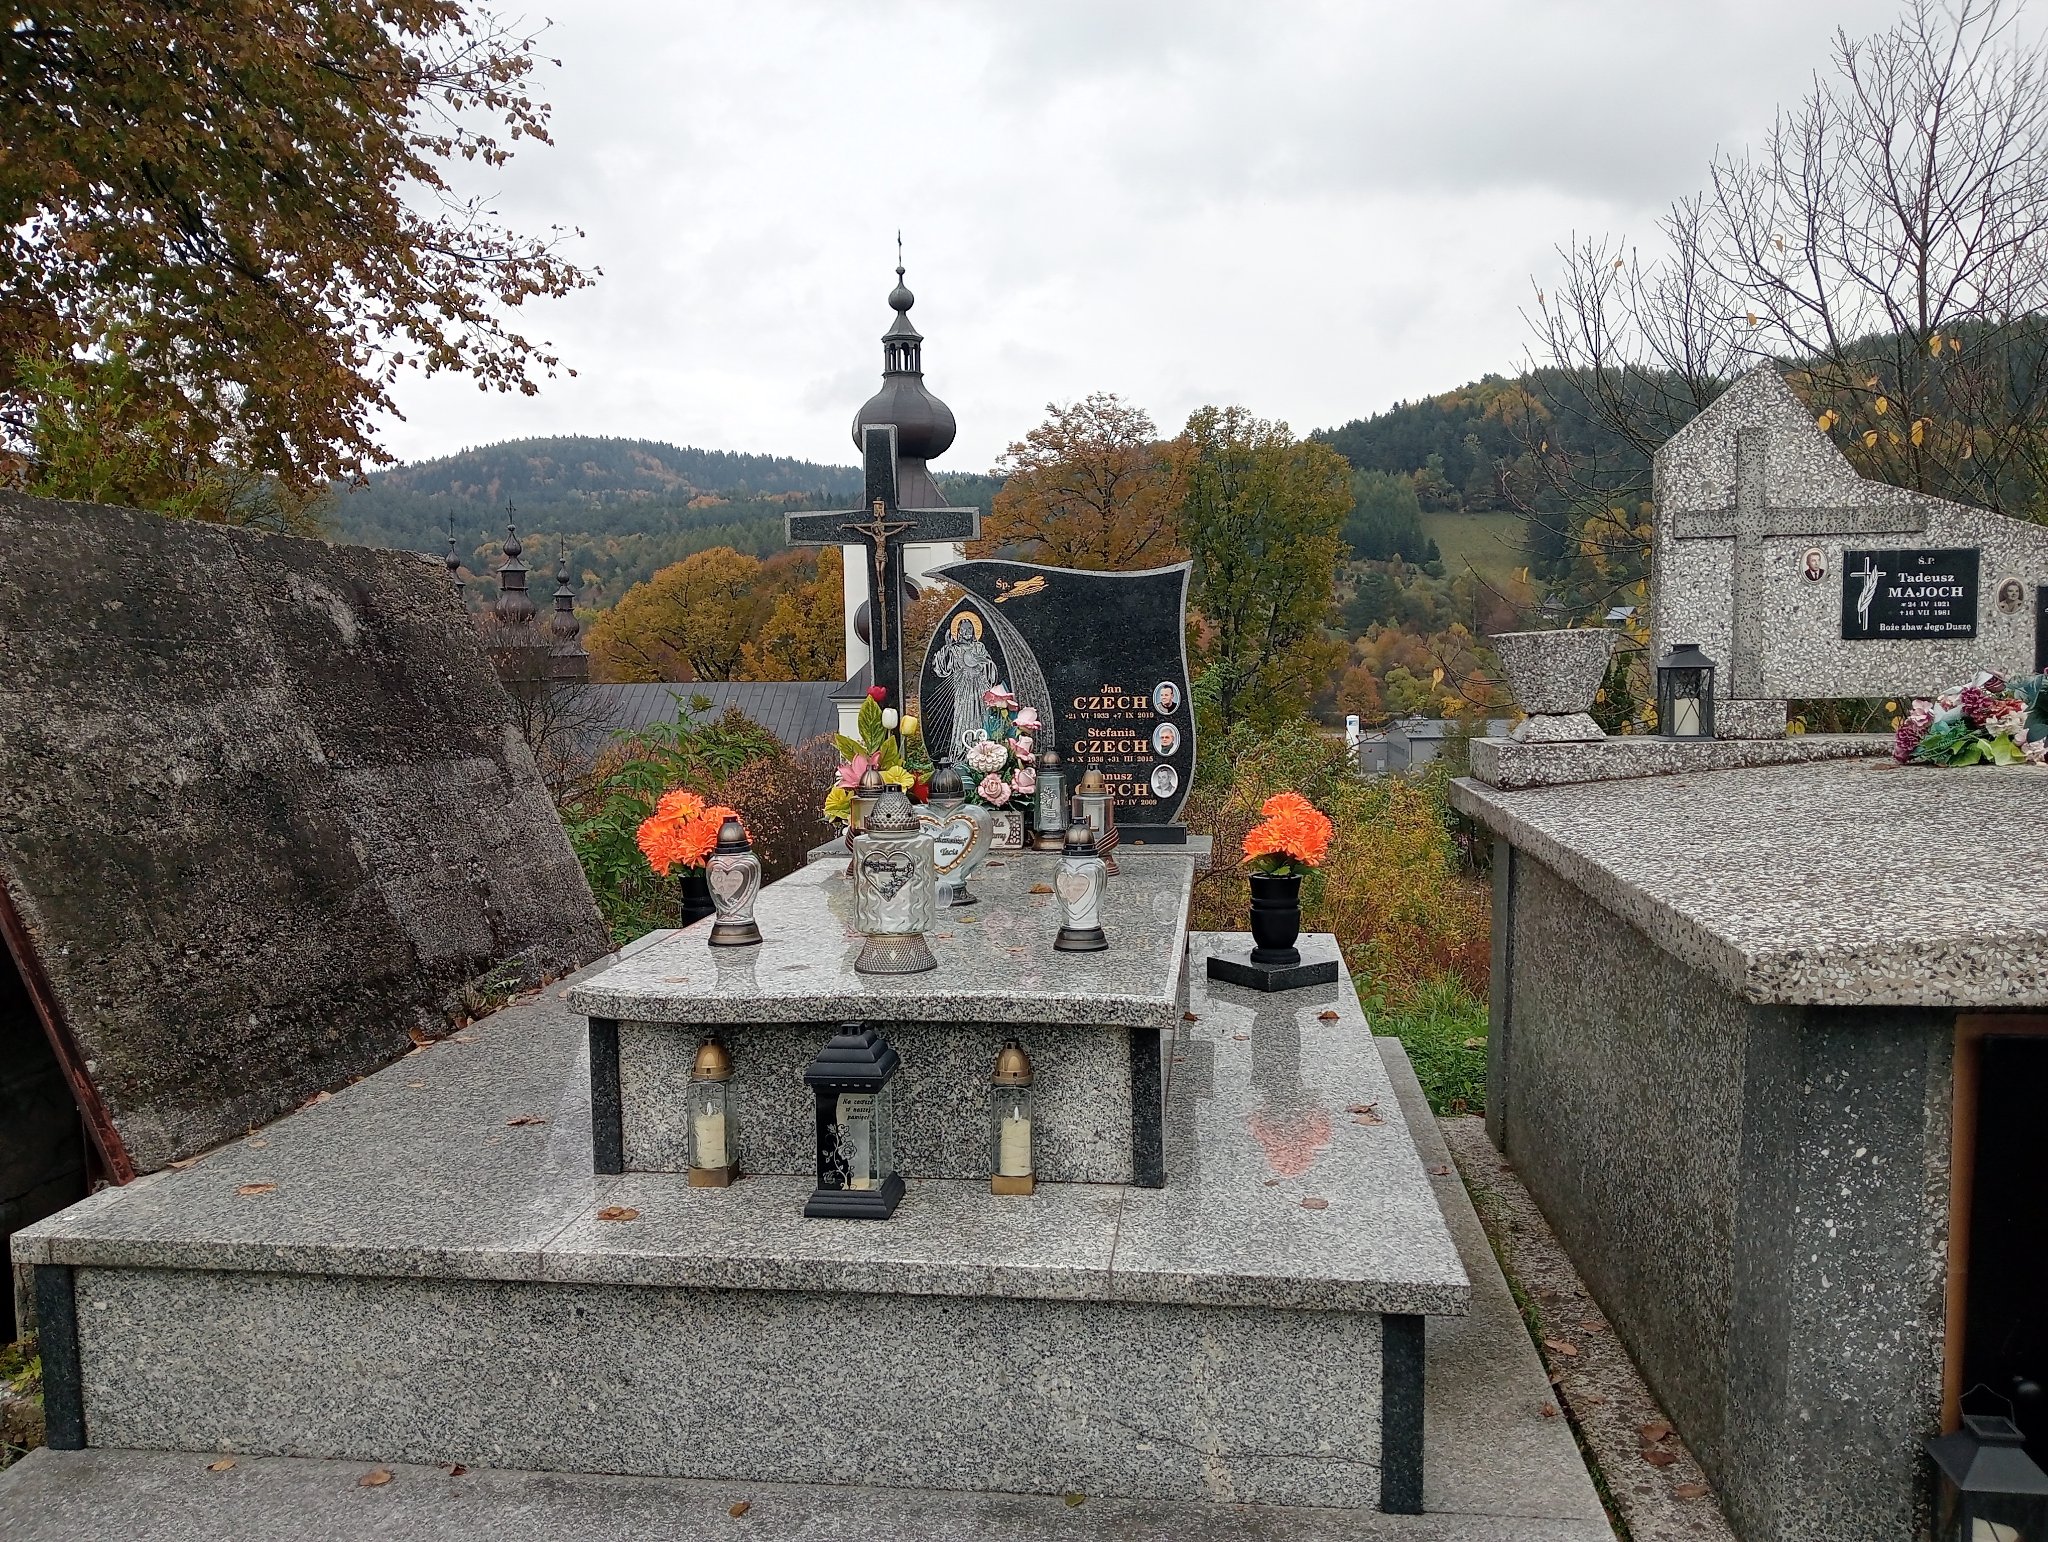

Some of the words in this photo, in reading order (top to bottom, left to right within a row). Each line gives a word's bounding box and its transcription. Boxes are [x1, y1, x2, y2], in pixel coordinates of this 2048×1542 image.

[1898, 573, 1955, 583] Tadeusz
[1888, 586, 1964, 598] MAJOCH
[1879, 623, 1900, 631] Boże
[1901, 622, 1923, 631] zbaw
[1924, 622, 1945, 632] Jego
[1945, 622, 1972, 631] Duszę
[1100, 683, 1122, 694] Jan
[1073, 696, 1149, 710] CZECH
[1087, 727, 1136, 737] Stefania
[1074, 739, 1149, 753] CZECH
[1101, 772, 1133, 781] anusz
